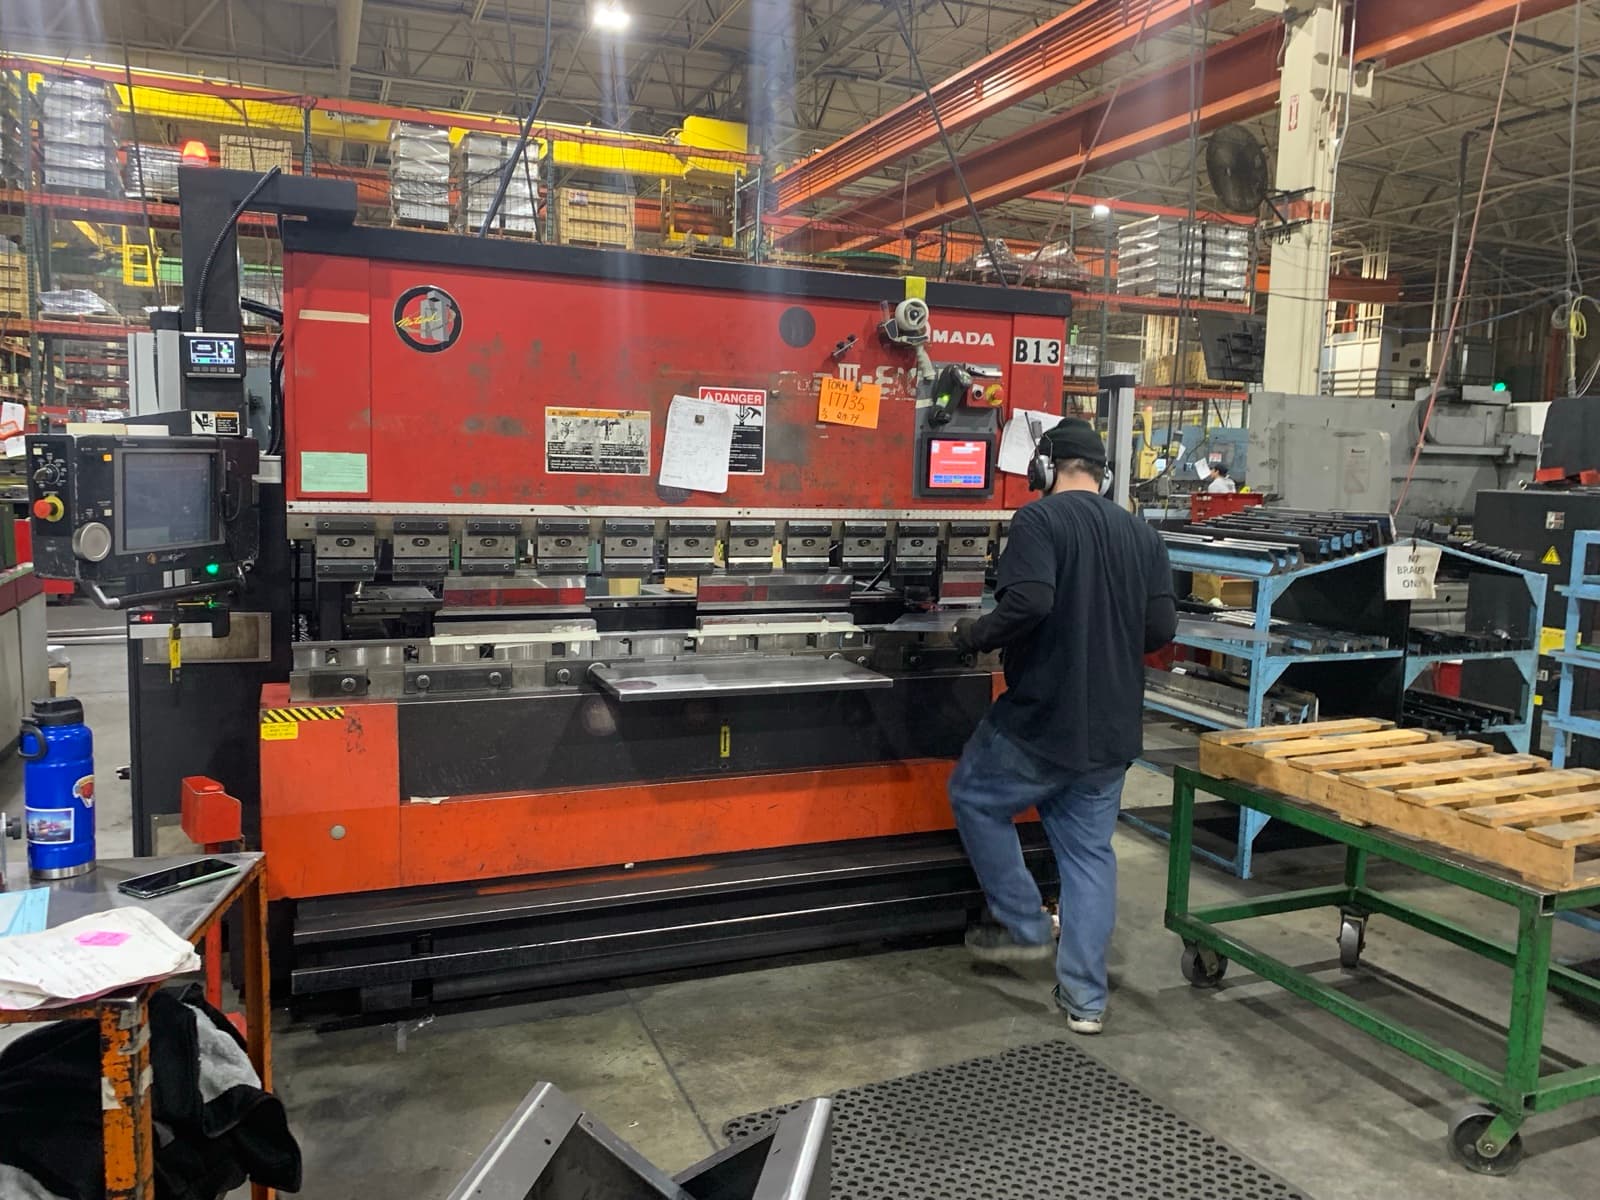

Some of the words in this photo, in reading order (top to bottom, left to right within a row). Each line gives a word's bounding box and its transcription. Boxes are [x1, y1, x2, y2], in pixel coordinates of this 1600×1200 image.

[928, 326, 995, 346] MADA
[1015, 338, 1061, 364] B13
[714, 392, 763, 405] DANGER
